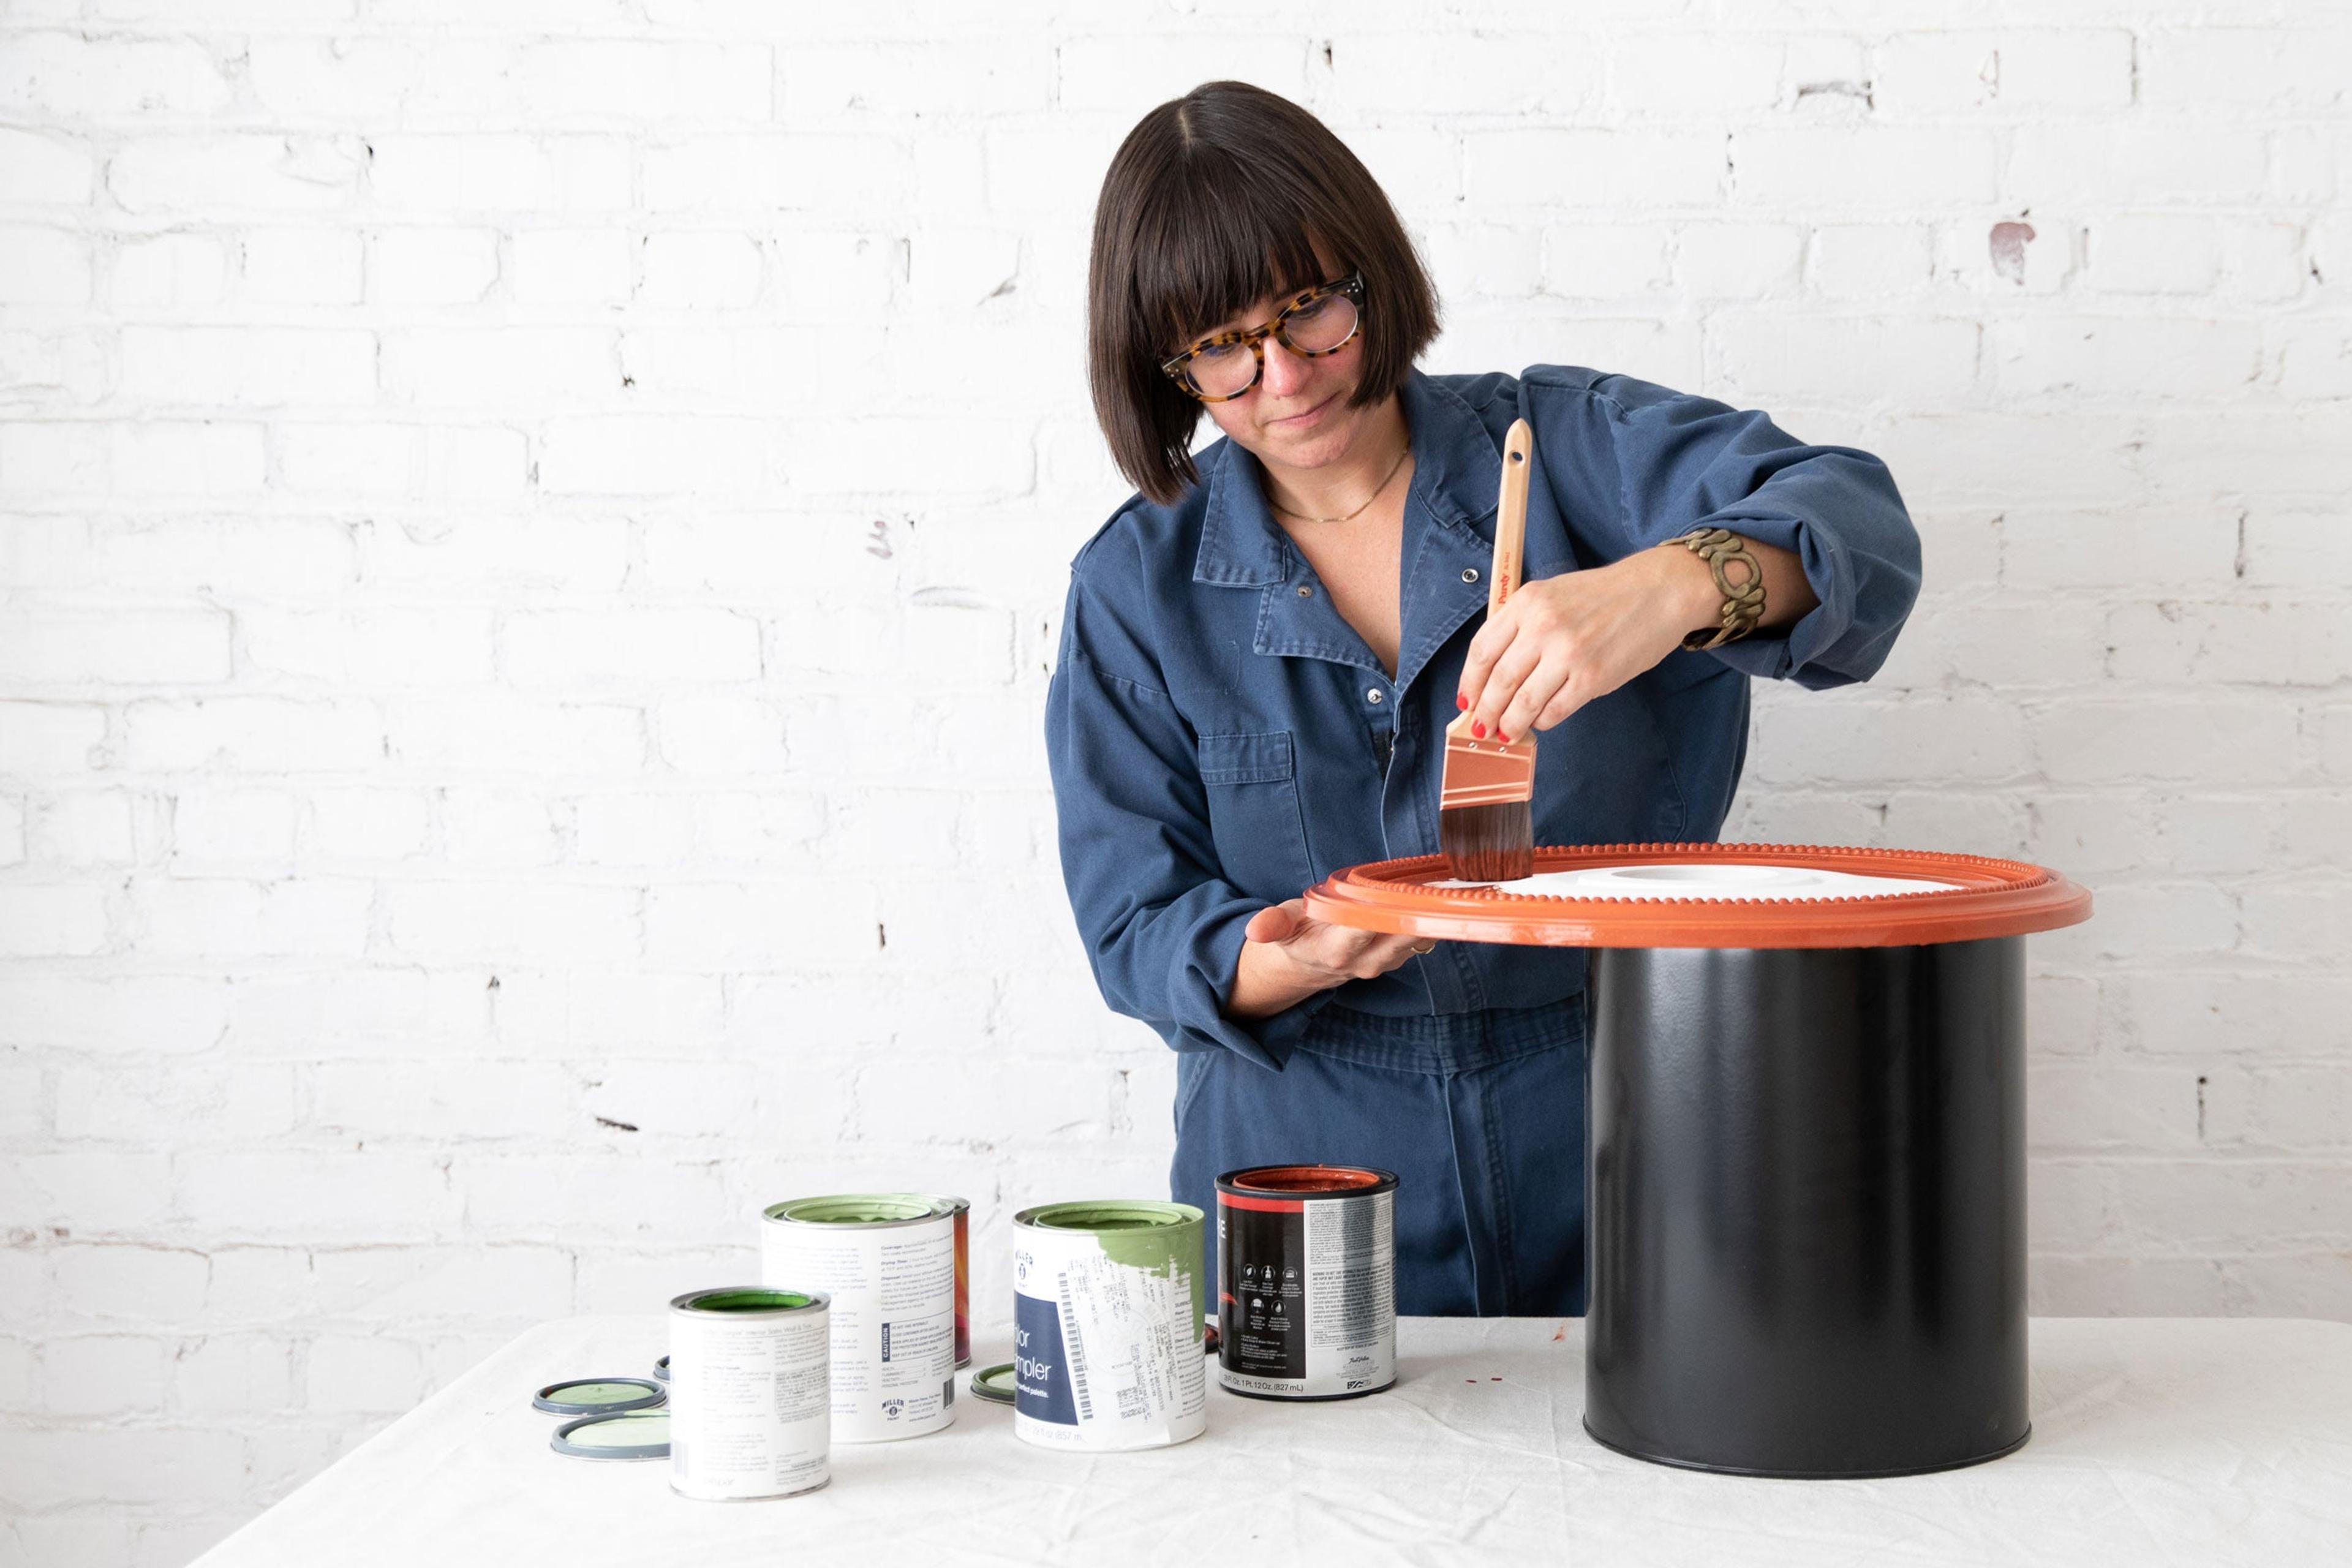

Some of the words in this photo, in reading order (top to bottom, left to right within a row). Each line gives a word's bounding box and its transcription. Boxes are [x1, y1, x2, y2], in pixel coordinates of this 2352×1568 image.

[1498, 573, 1510, 604] Purdy
[1262, 1382, 1273, 1390] Oz.
[1274, 1383, 1289, 1392] (827
[1290, 1384, 1303, 1392] mL)
[881, 1398, 905, 1409] MILLER
